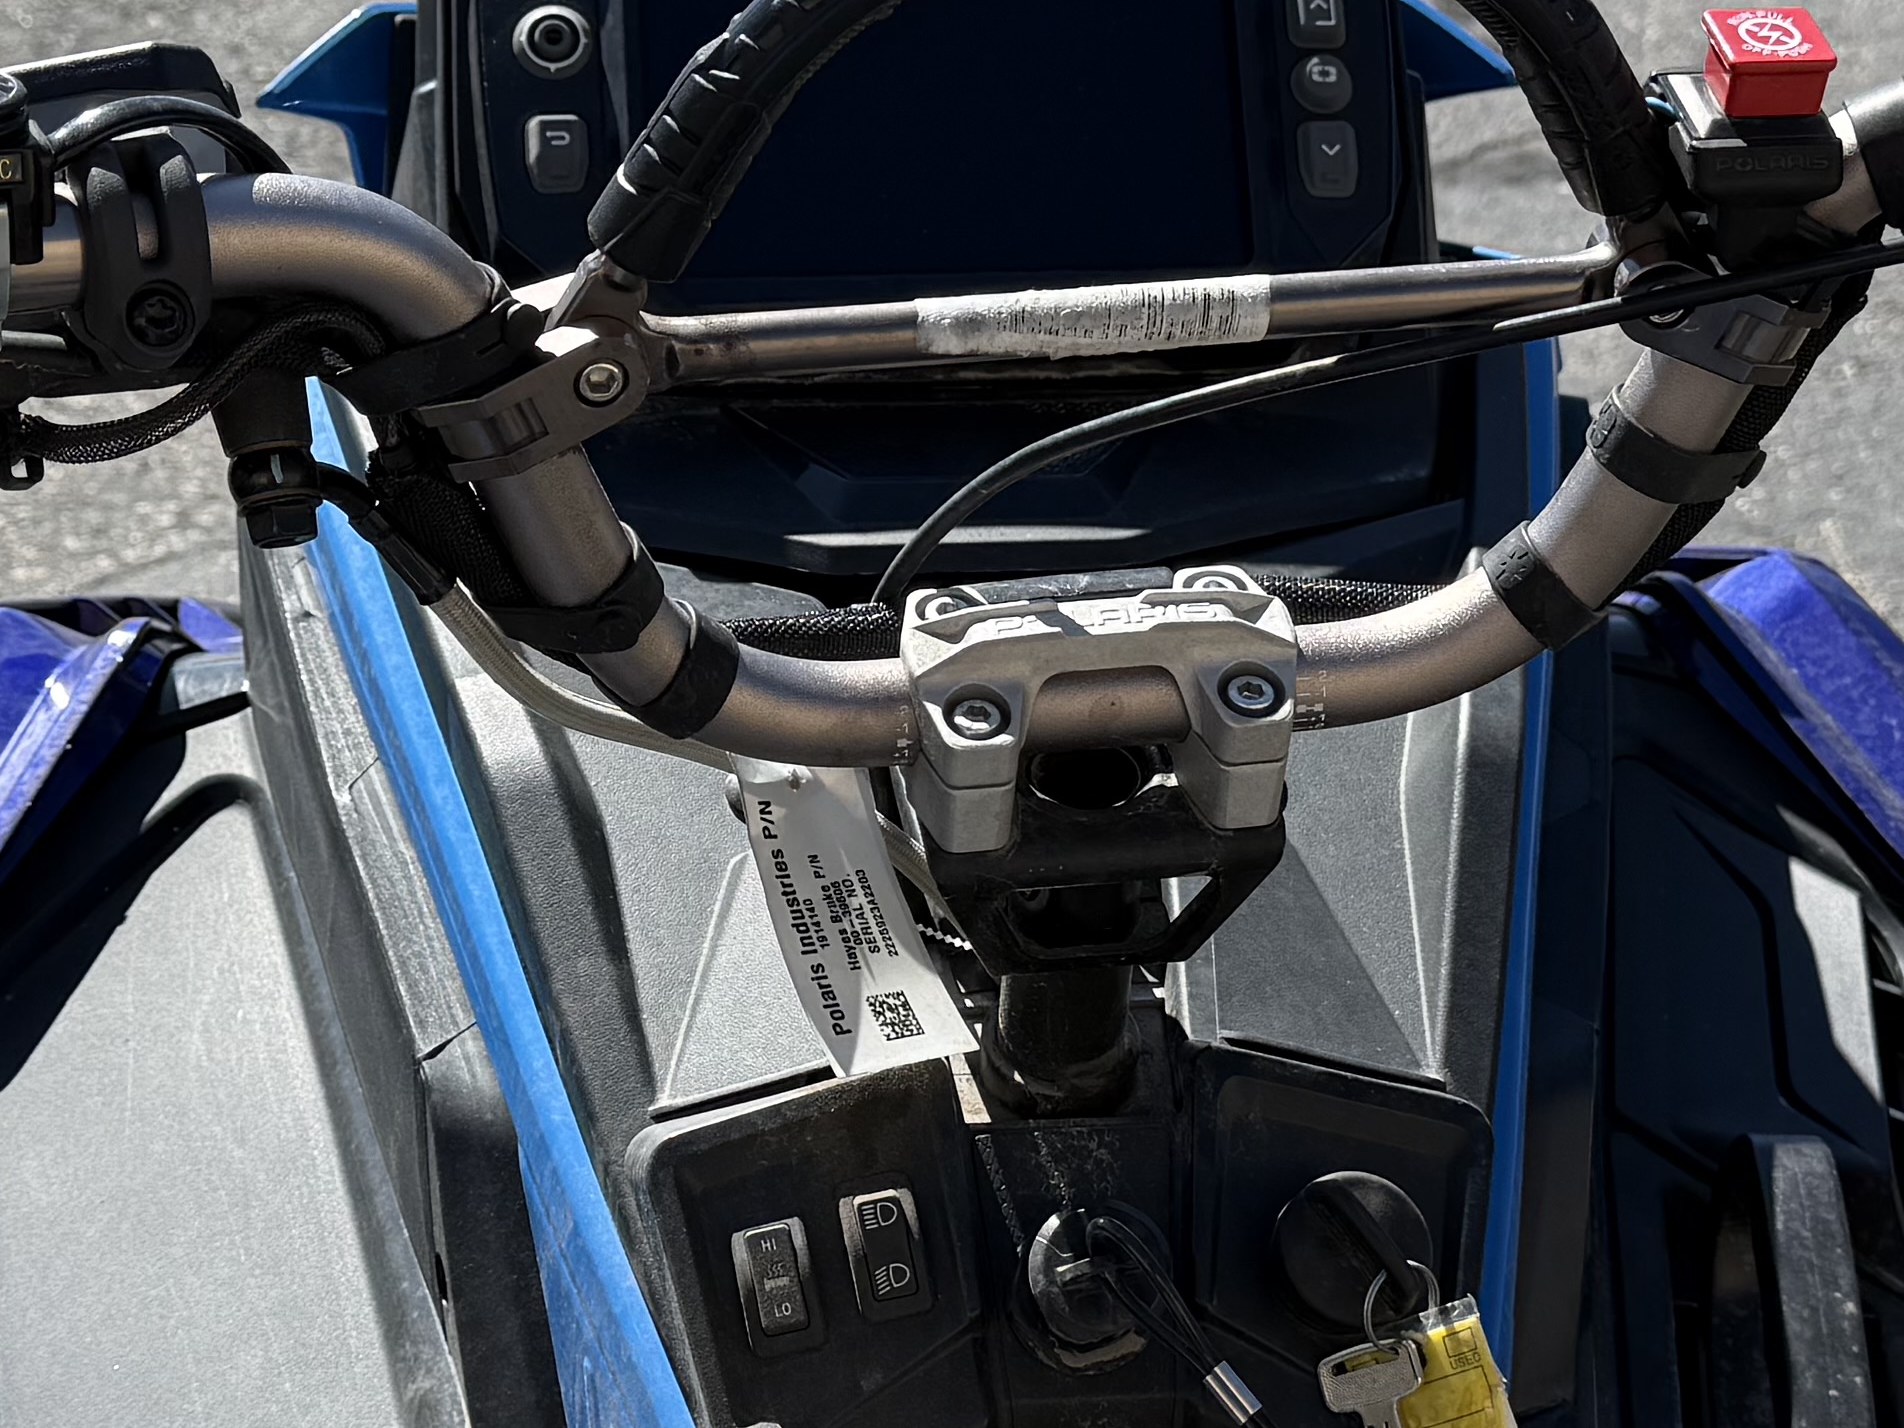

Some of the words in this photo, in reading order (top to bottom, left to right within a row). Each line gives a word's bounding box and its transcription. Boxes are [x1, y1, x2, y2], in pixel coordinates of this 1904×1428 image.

[1716, 155, 1829, 172] POLARIS
[757, 800, 779, 840] P/N
[807, 854, 826, 879] P/N
[841, 873, 859, 900] NO.
[771, 847, 818, 956] Industries
[802, 898, 830, 950] 1914140
[853, 903, 881, 954] SERIAL
[836, 922, 862, 971] Hayes
[810, 962, 853, 1036] Polaris
[760, 1239, 778, 1252] HI
[773, 1302, 792, 1318] LO
